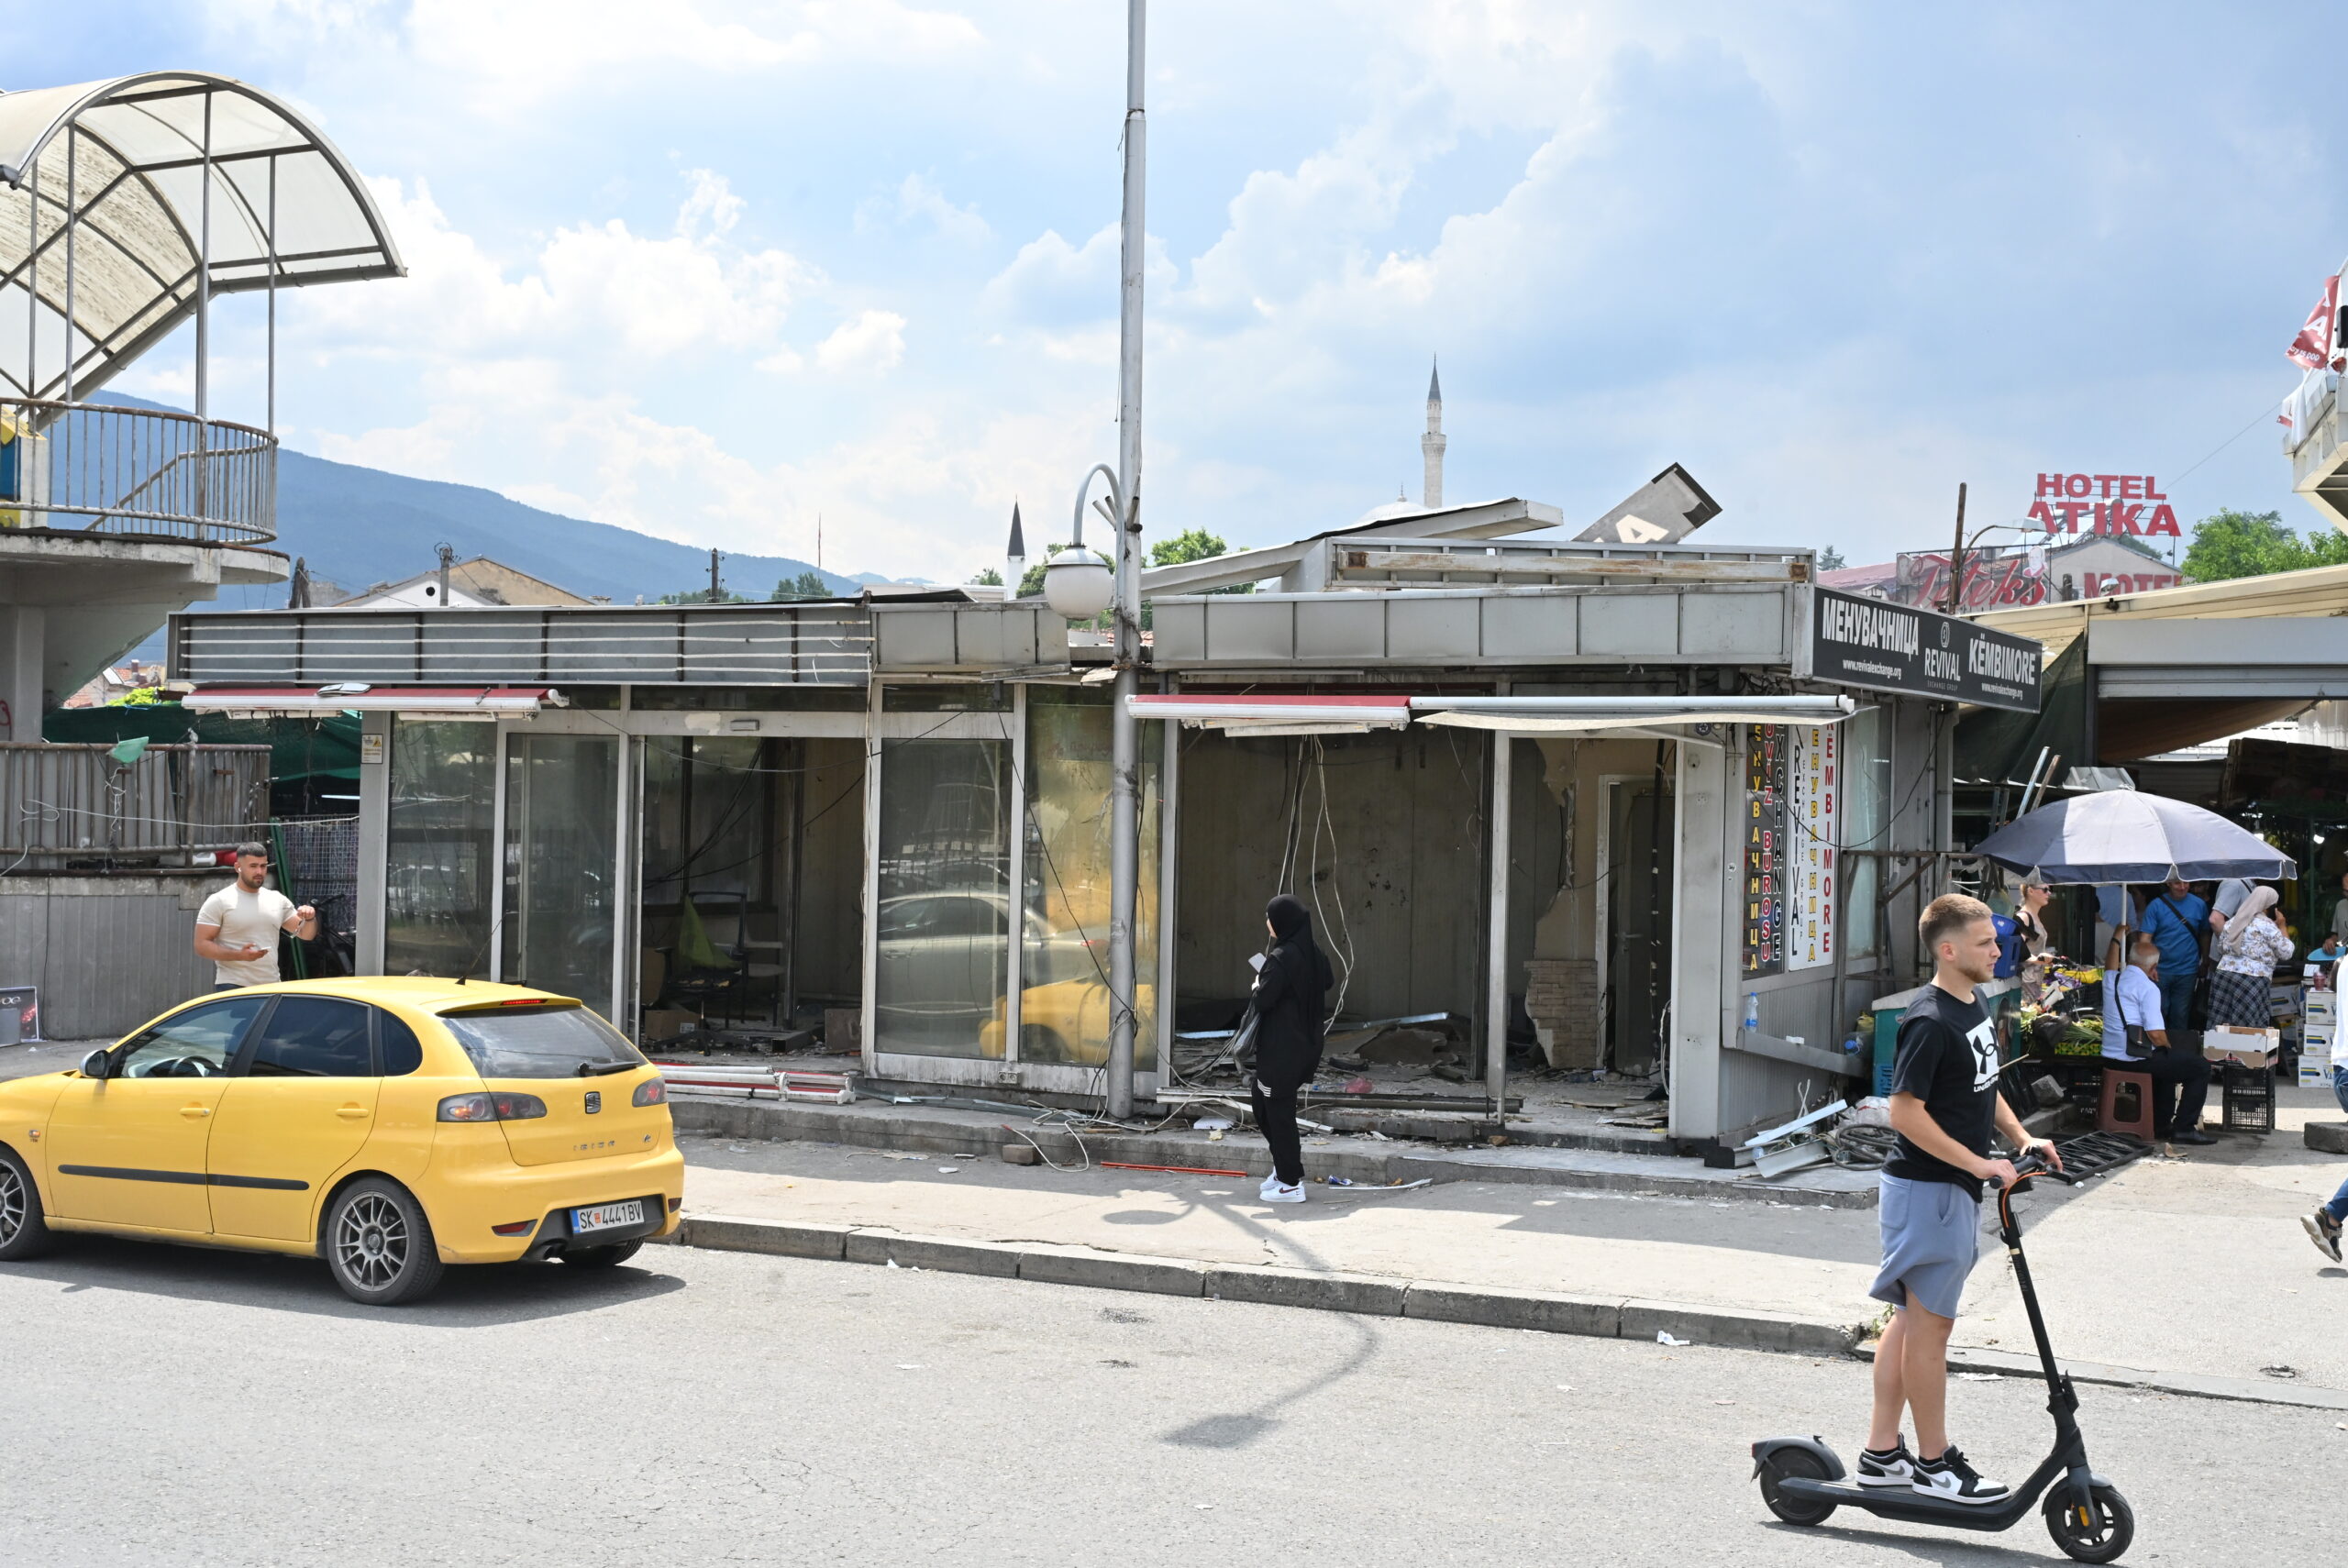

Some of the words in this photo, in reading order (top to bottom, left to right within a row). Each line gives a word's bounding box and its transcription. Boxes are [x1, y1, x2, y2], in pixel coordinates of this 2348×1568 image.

[2037, 473, 2167, 500] HOTEL
[2027, 501, 2182, 536] ATIKA
[1822, 597, 1919, 661] МЕНУВАЧНИЦА
[1843, 659, 1902, 680] www.revivalexchange.org
[1924, 647, 1961, 681] REVIVAL
[1968, 633, 2036, 685] KËMBIMORE
[1750, 724, 1762, 970] ЕНУВАЧНИЦА
[1772, 723, 1785, 961] XCHANGE
[1791, 745, 1801, 955] REVIVAL
[1808, 728, 1820, 962] ЕНУВАЧНИЦА
[580, 1210, 594, 1230] SK
